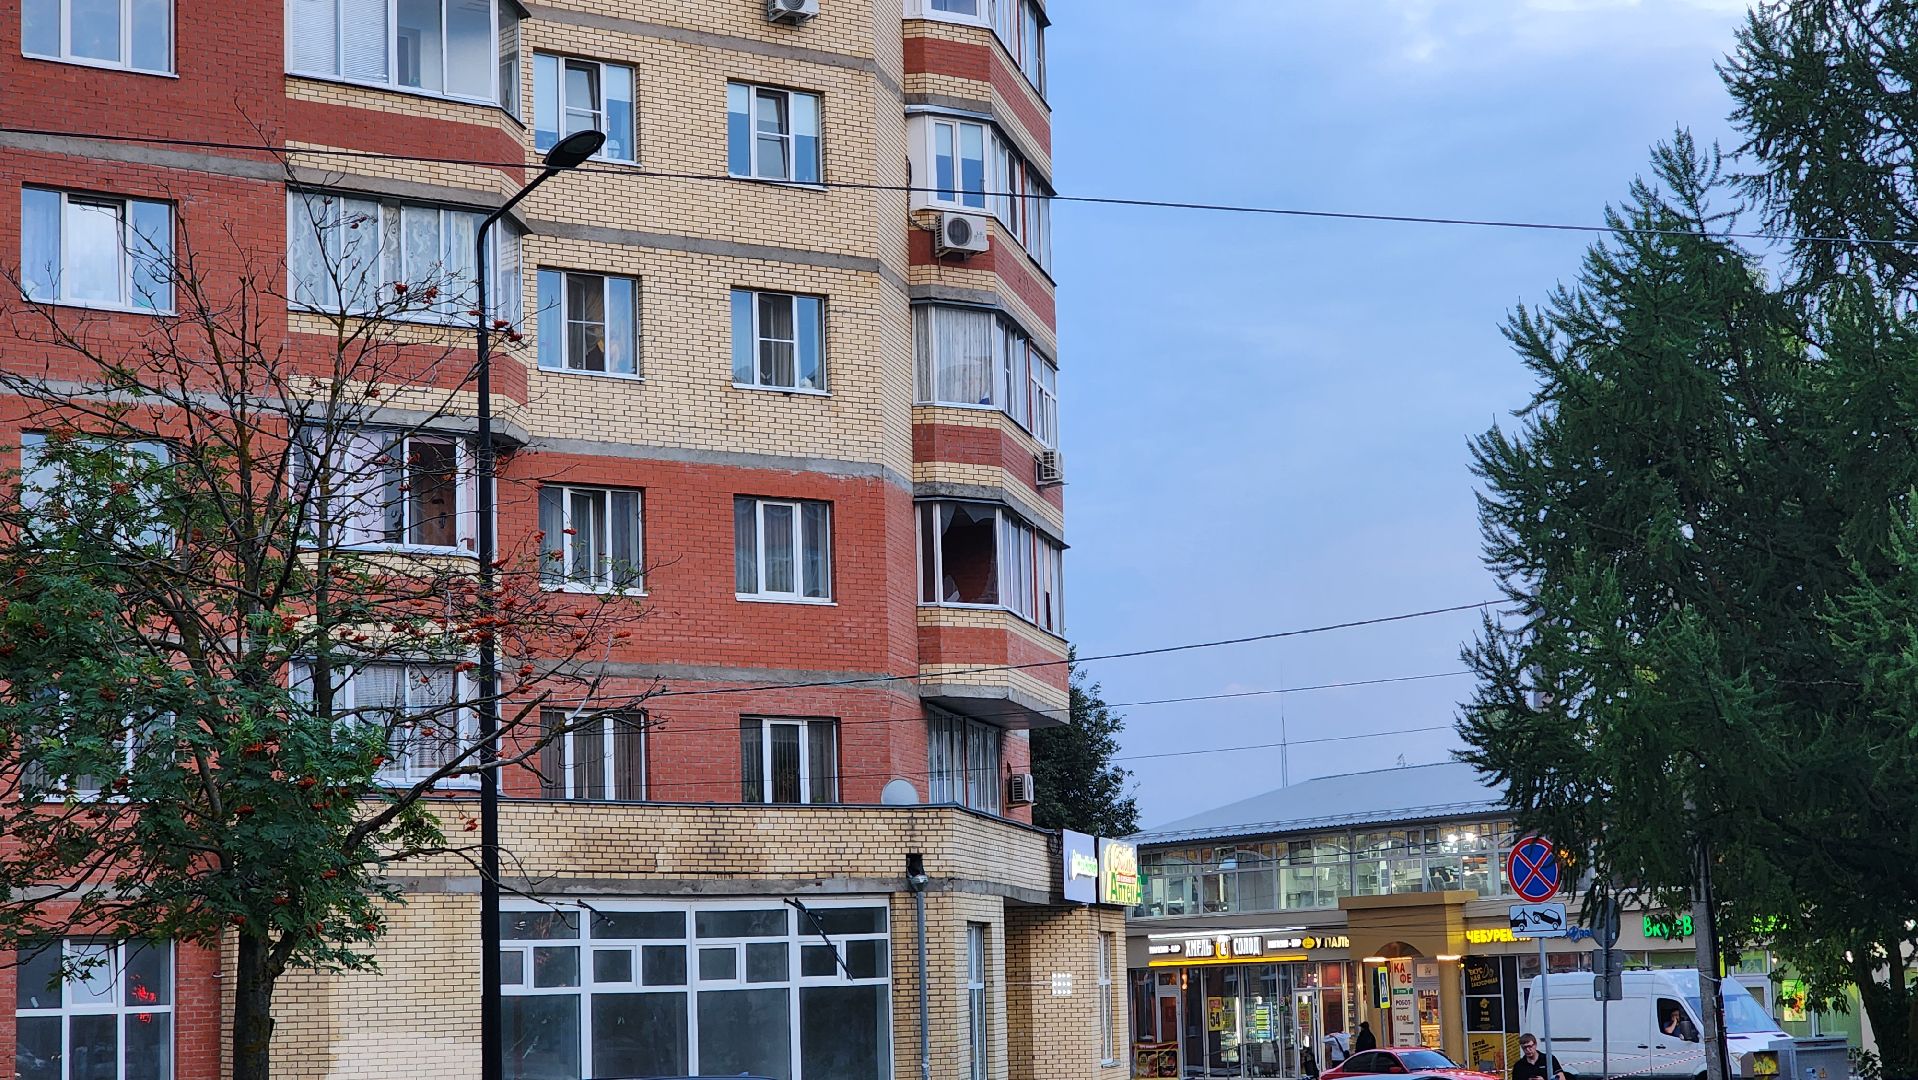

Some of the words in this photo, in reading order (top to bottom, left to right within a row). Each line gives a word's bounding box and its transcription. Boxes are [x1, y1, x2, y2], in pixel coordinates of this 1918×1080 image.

[1185, 938, 1214, 958] ХМЕЛЬ
[1233, 936, 1262, 956] СОЛОД
[1394, 962, 1406, 973] КА
[1400, 974, 1412, 984] ФЕ
